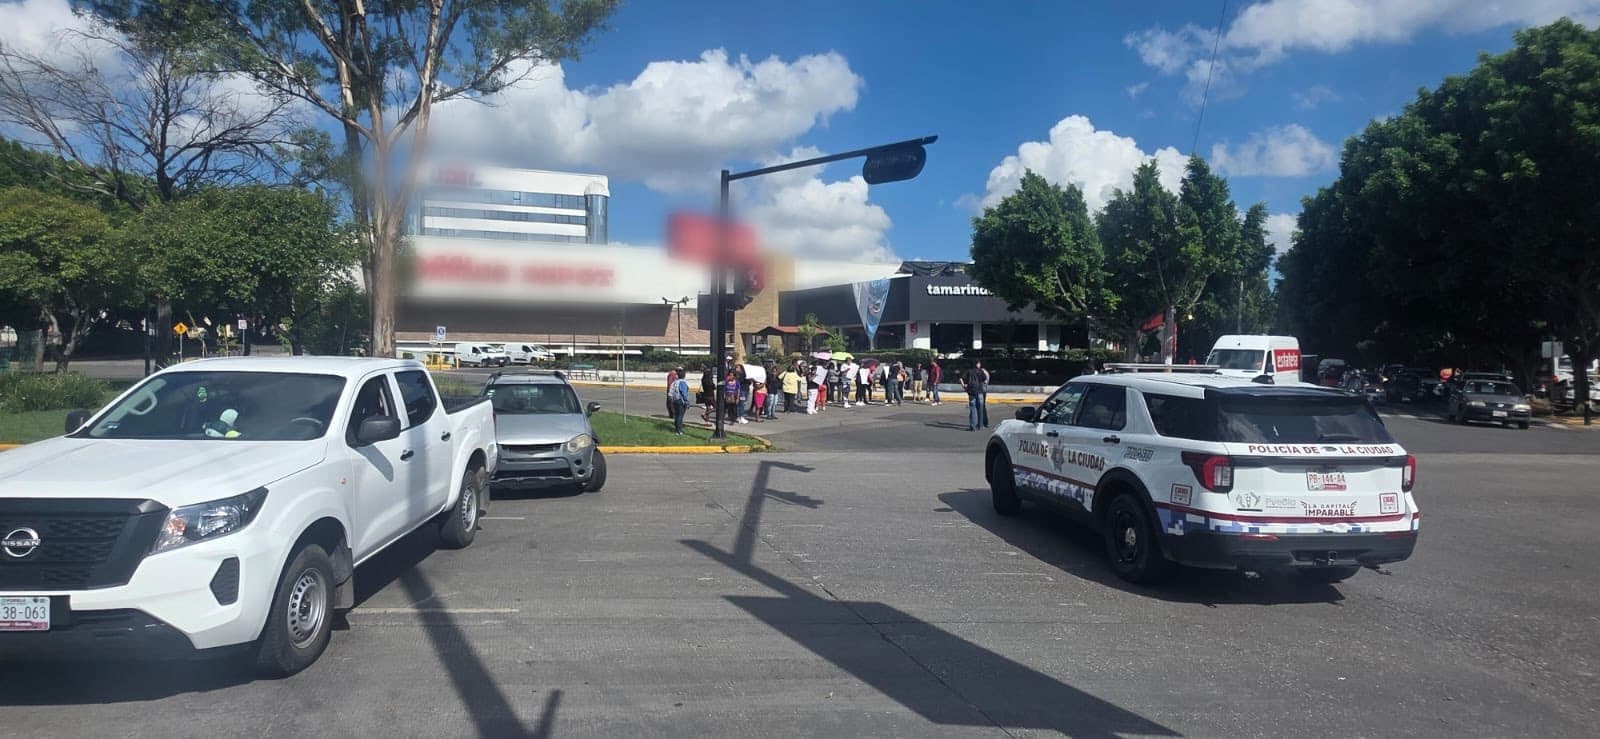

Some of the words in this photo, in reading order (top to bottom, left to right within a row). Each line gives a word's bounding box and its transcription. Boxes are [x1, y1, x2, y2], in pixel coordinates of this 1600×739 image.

[1277, 351, 1299, 368] estafeta
[1040, 443, 1049, 458] DE
[1302, 446, 1320, 454] DE
[1340, 446, 1357, 454] LA
[1356, 446, 1394, 454] CIUDAD
[1068, 448, 1077, 465] LA
[1077, 451, 1105, 471] CIUDAD
[1305, 509, 1355, 517] IMPARABLE
[1, 539, 41, 547] NISSAN
